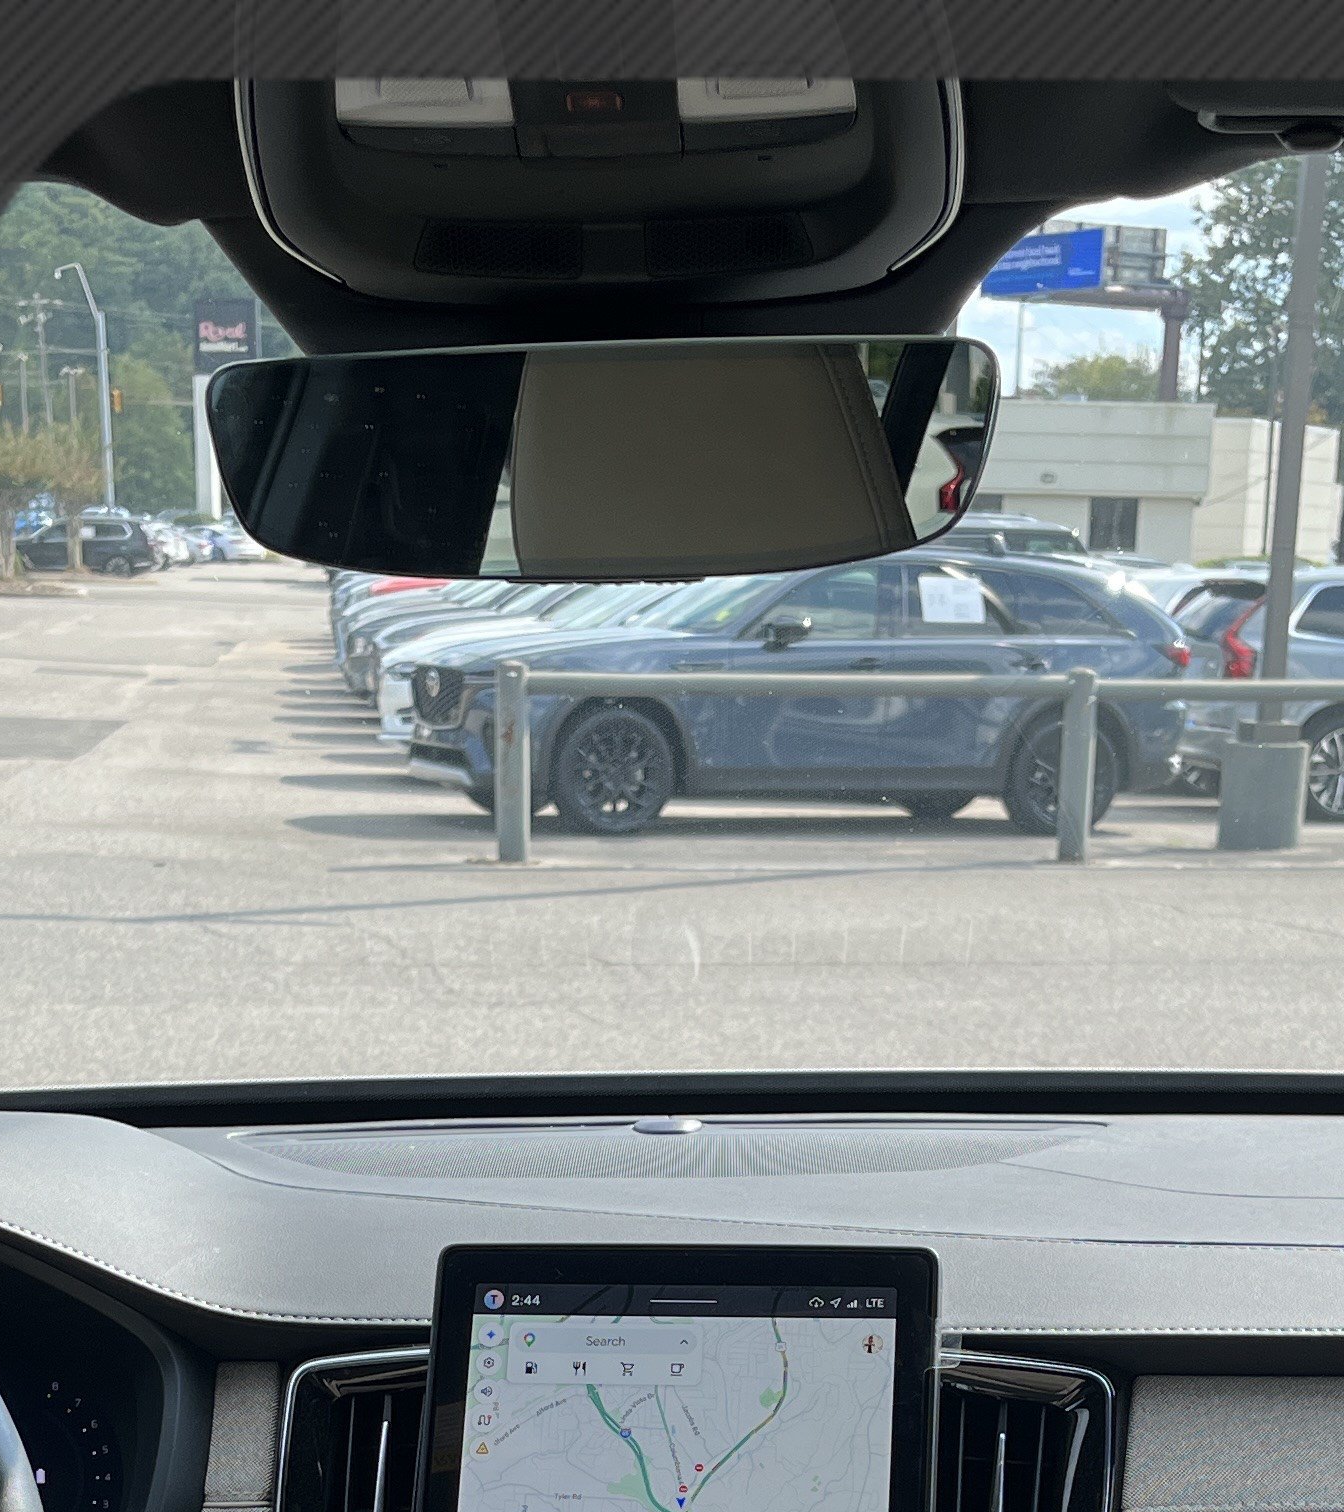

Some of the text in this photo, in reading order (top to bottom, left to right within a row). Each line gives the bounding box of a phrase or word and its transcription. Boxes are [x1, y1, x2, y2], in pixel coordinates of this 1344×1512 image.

[511, 1294, 541, 1307] 2:44
[865, 1298, 885, 1309] LTE
[585, 1335, 626, 1347] Search
[75, 1398, 82, 1408] 7
[90, 1419, 98, 1429] 6
